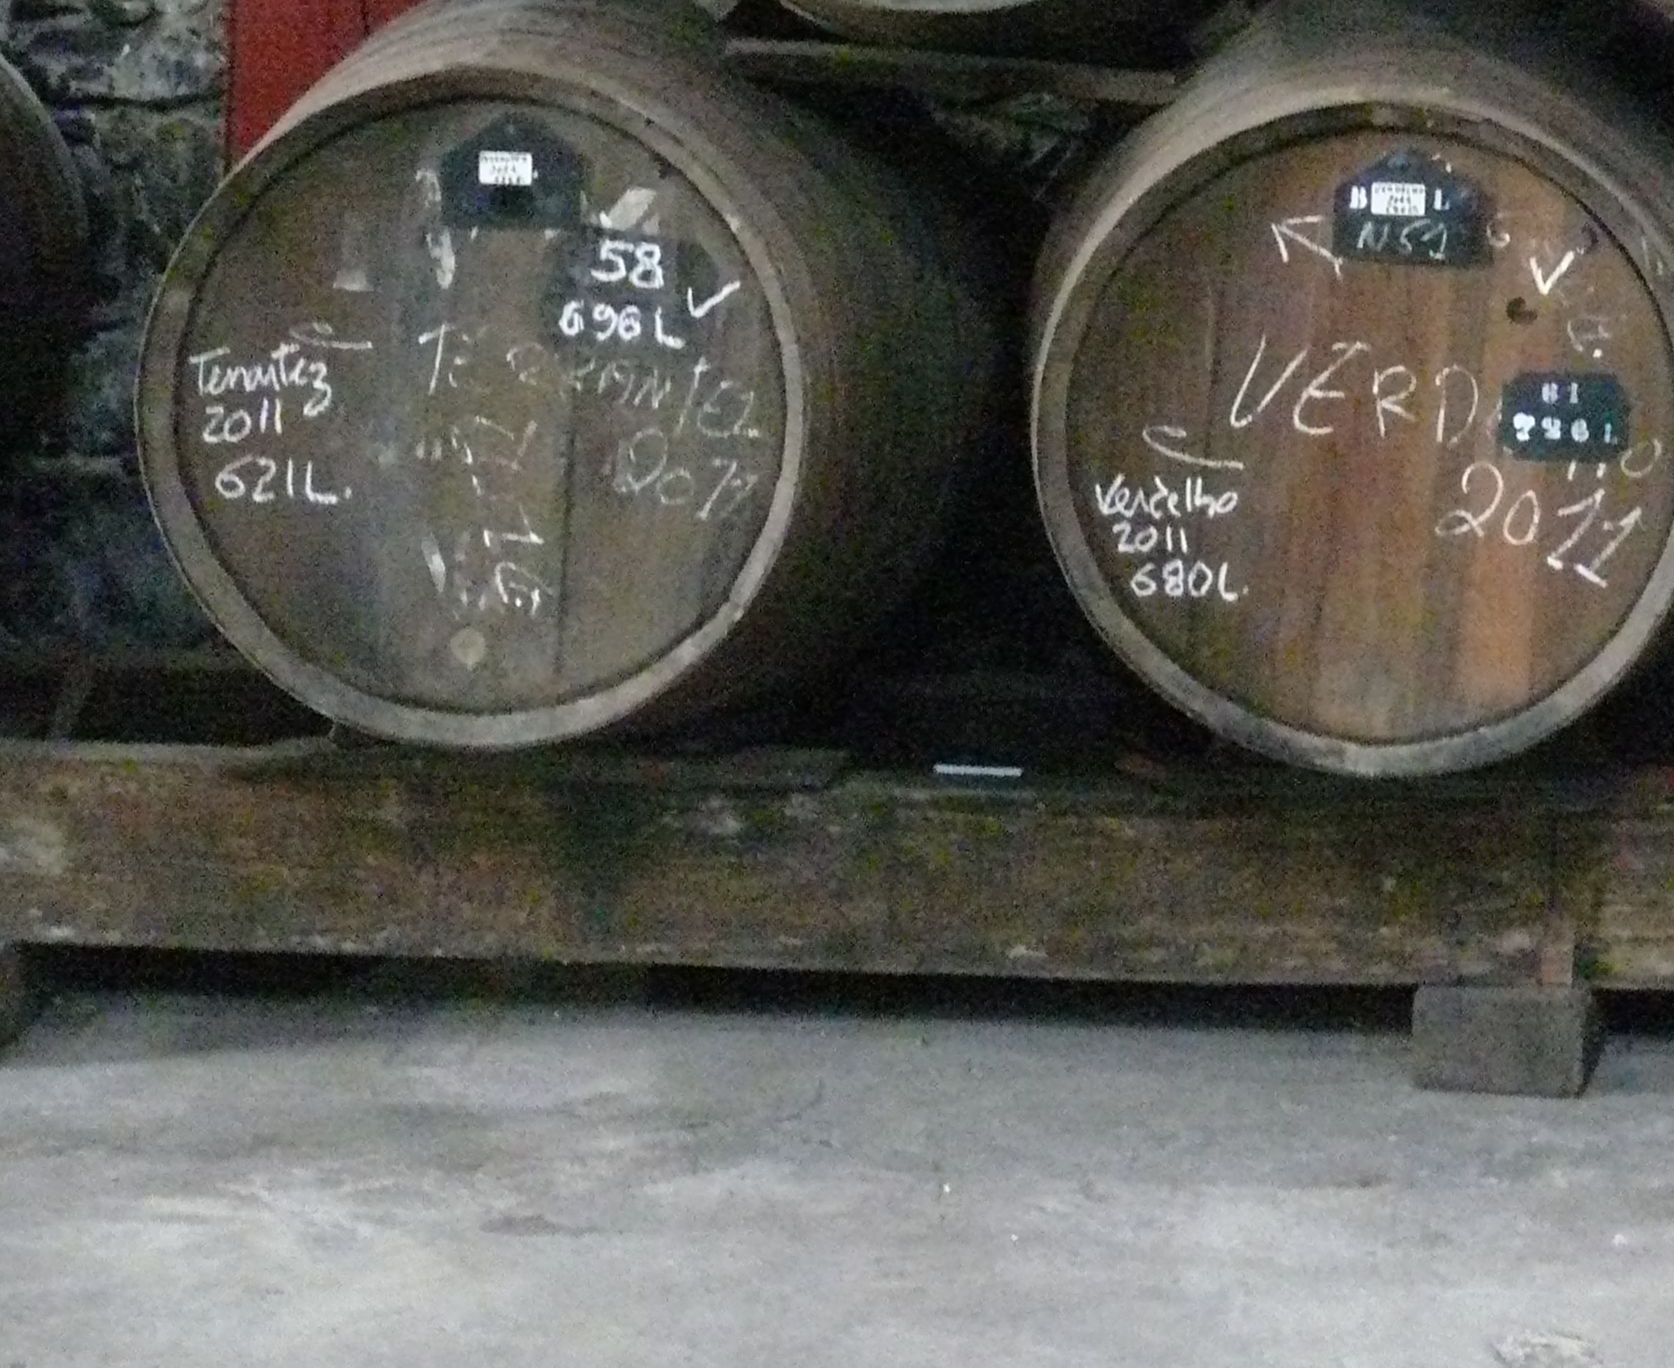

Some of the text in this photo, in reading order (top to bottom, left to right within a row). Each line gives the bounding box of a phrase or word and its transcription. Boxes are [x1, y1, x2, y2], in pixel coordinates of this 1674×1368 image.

[590, 239, 664, 289] 58
[202, 397, 283, 444] 2011
[1111, 519, 1189, 555] 2011
[1434, 461, 1643, 589] 2011
